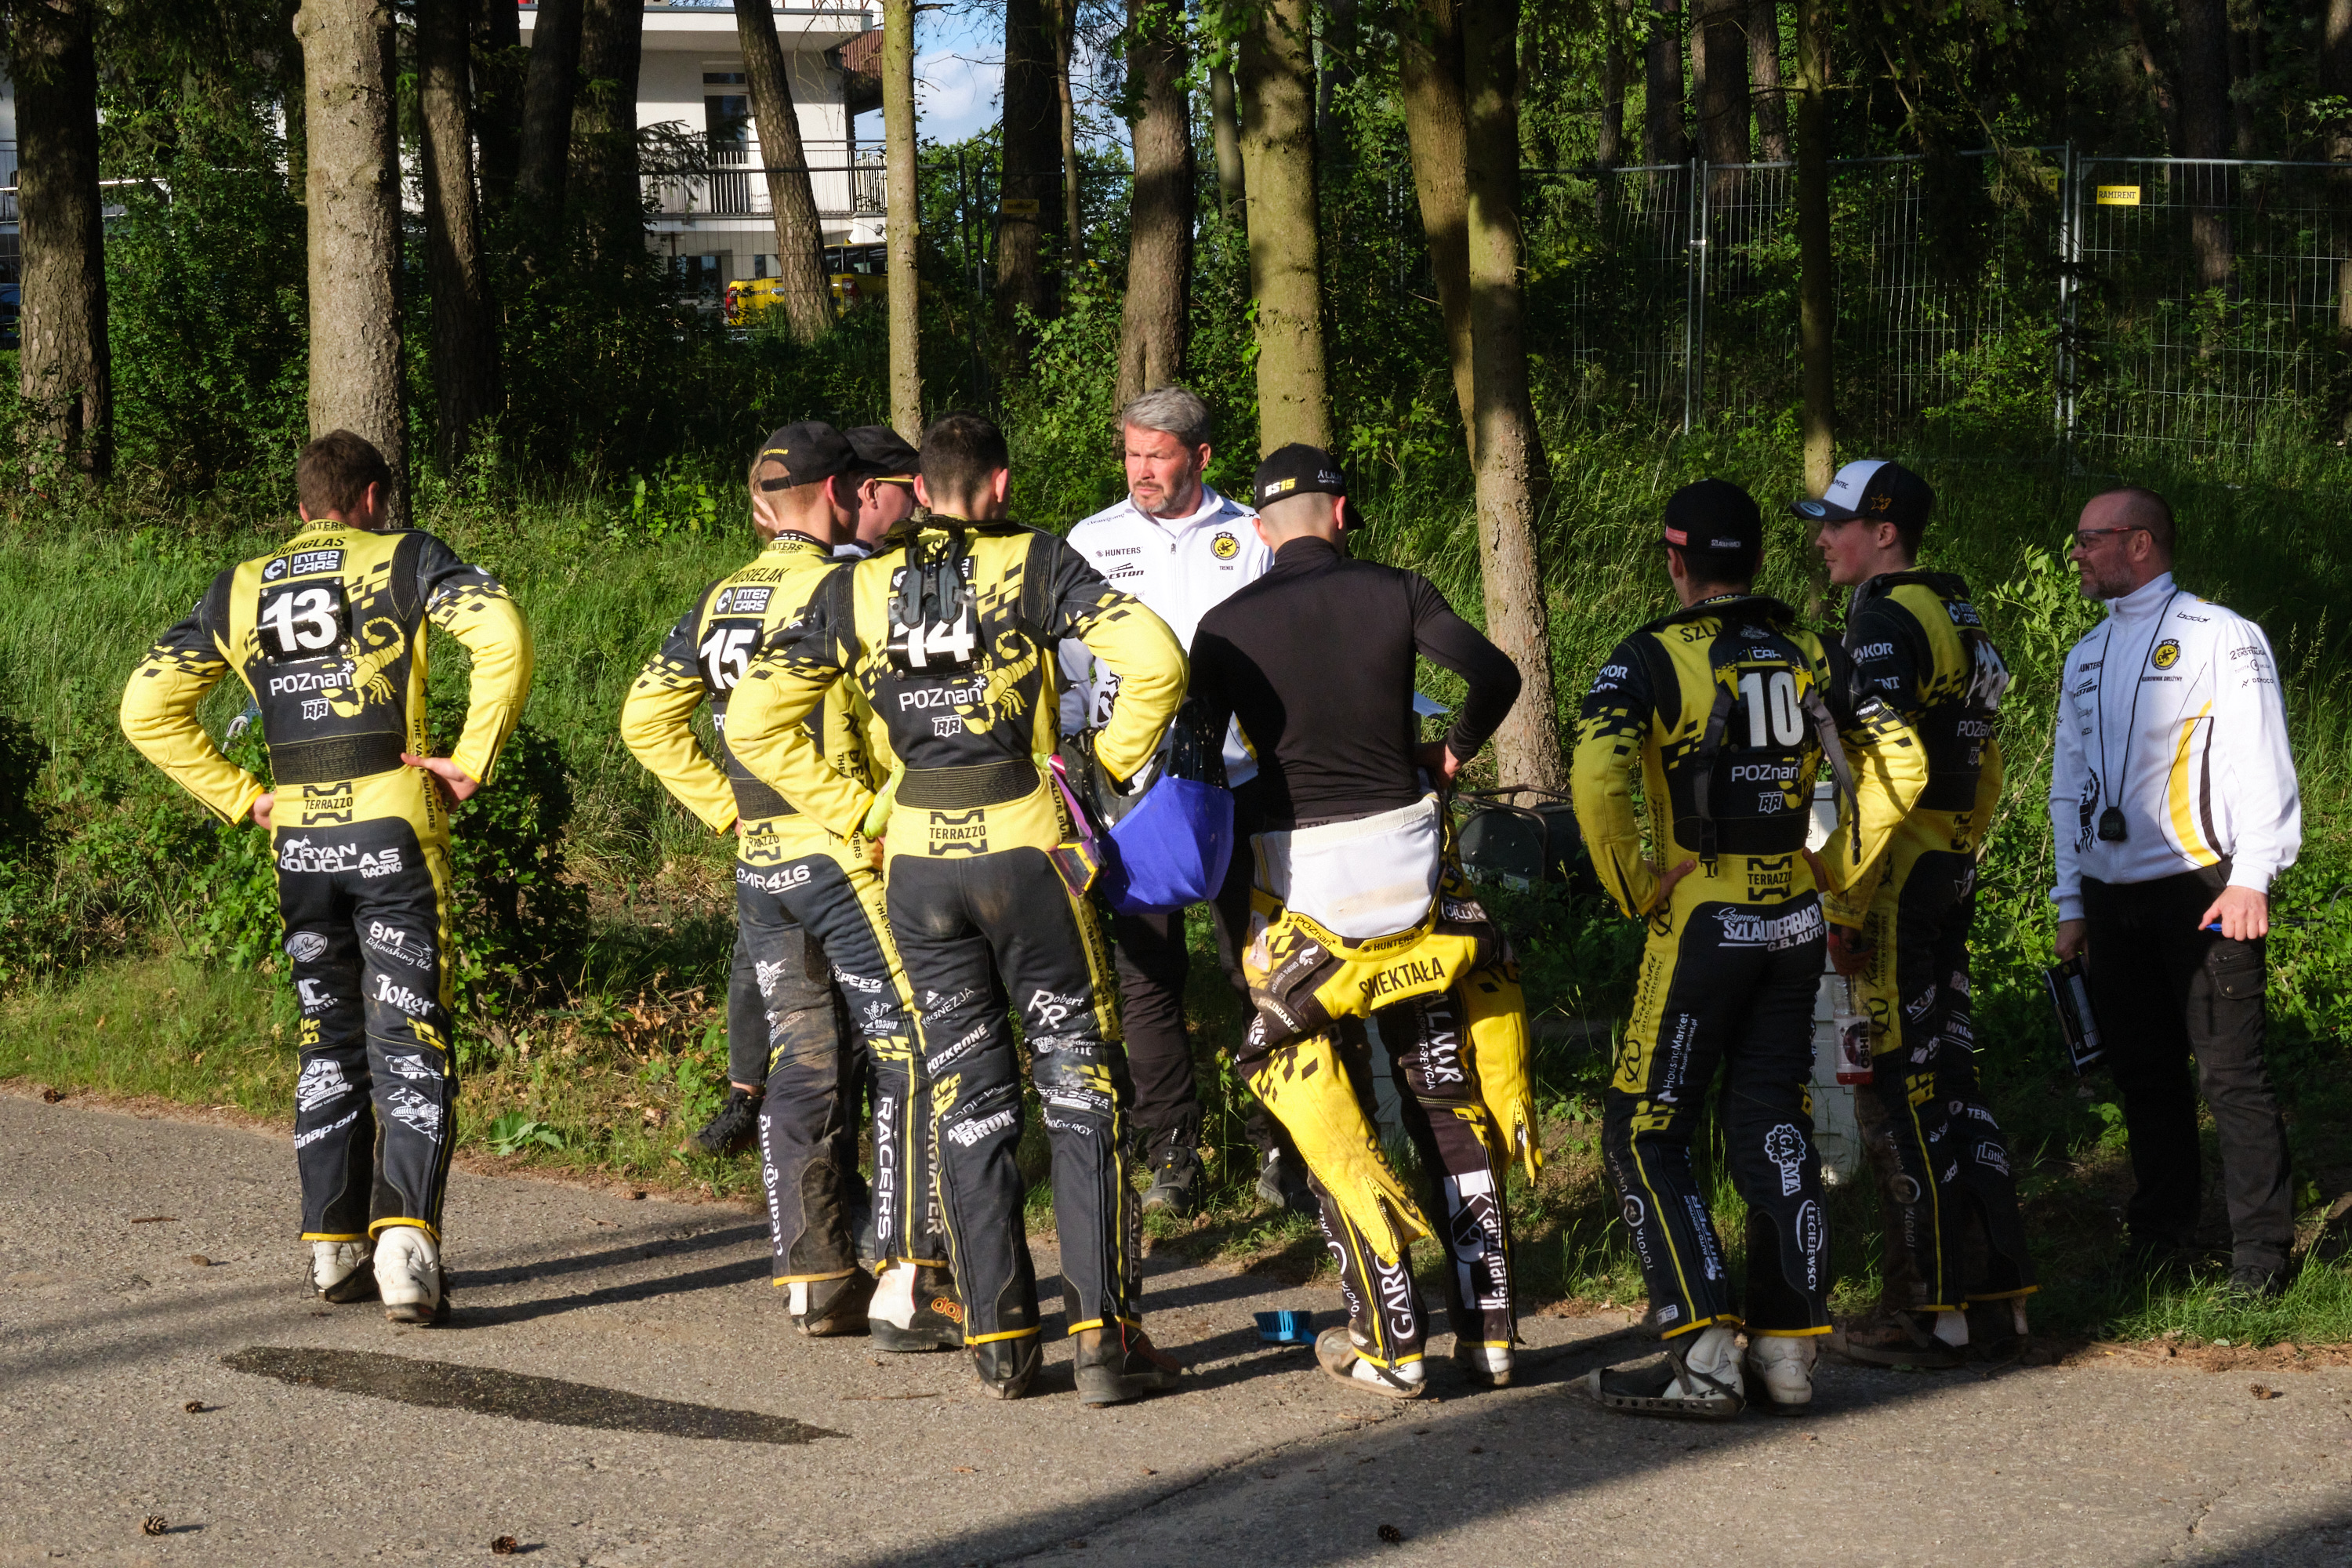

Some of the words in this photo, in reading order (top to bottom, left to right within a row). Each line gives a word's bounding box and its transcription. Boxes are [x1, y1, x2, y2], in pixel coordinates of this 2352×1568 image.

[2098, 191, 2136, 199] RAMIRENT
[272, 536, 347, 557] DOUGLAS
[294, 550, 340, 564] INTER
[1105, 546, 1142, 557] HUNTERS
[292, 559, 339, 575] CARS
[729, 568, 791, 583] MUSIELAK
[732, 600, 766, 612] CARS
[735, 588, 771, 600] INTER
[262, 588, 337, 652] 13
[893, 602, 975, 668] 14
[699, 629, 756, 690] 15
[2230, 650, 2238, 660] 2
[1738, 671, 1804, 747] 10
[414, 717, 423, 740] THE
[305, 797, 354, 811] TERRAZZO
[929, 825, 987, 840] TERRAZZO
[299, 843, 358, 860] RYAN
[851, 833, 862, 859] DERS
[280, 848, 401, 873] DOUGLAS
[1748, 873, 1793, 886] TERRAZZO
[875, 900, 889, 923] THE
[1712, 907, 1761, 923] Szymon
[1723, 903, 1823, 942] SZLAUDERBACH
[369, 920, 406, 947] BM
[1374, 932, 1415, 952] HUNTERS
[1795, 925, 1825, 945] AUTO
[365, 937, 415, 966] Refinishing
[1359, 956, 1446, 1004] SMEKTAŁA
[372, 974, 435, 1017] Joker
[921, 987, 975, 1029] MAGNEZJA
[927, 1023, 988, 1074] POZKRONE
[1662, 1012, 1690, 1090] HousingMarket
[1860, 1020, 1870, 1069] OSHEE
[310, 1086, 340, 1102] autocraft
[947, 1117, 977, 1142] APS
[954, 1109, 1017, 1149] BRUK
[876, 1096, 895, 1240] RACERS
[1636, 1228, 1654, 1271] TOYOTA
[1806, 1206, 1817, 1292] LECIEJEWSCY
